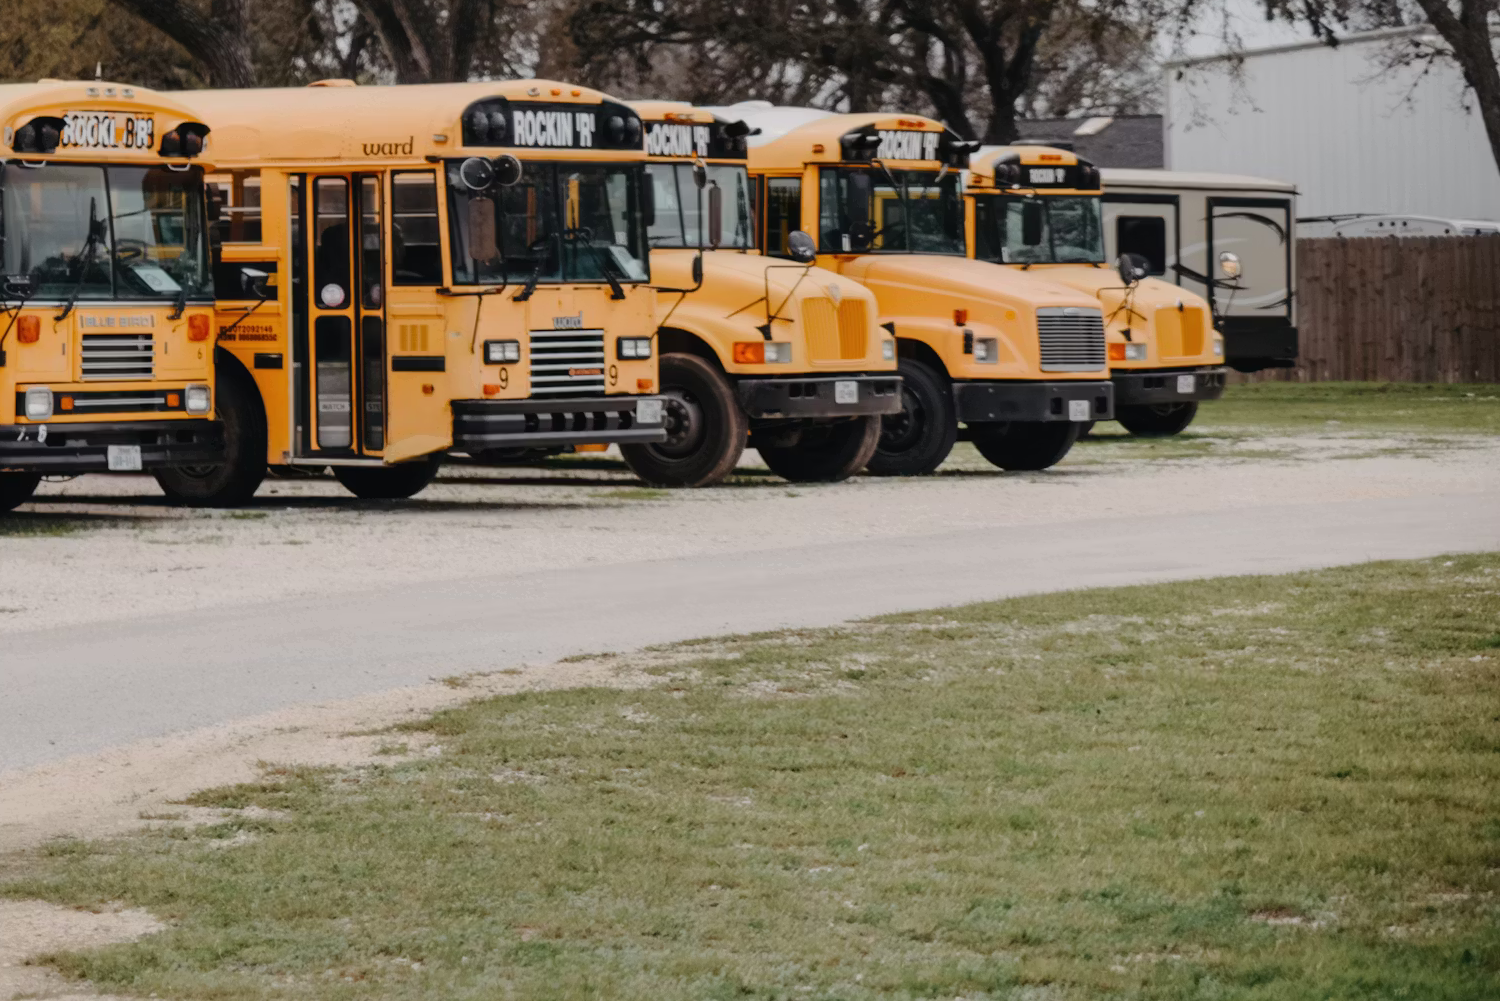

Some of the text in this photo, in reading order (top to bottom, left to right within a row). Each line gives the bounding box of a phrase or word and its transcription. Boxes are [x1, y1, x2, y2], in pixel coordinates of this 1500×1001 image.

[513, 110, 573, 146] ROCKIN
[363, 136, 414, 156] ward
[499, 367, 509, 390] 9
[608, 364, 619, 387] 9
